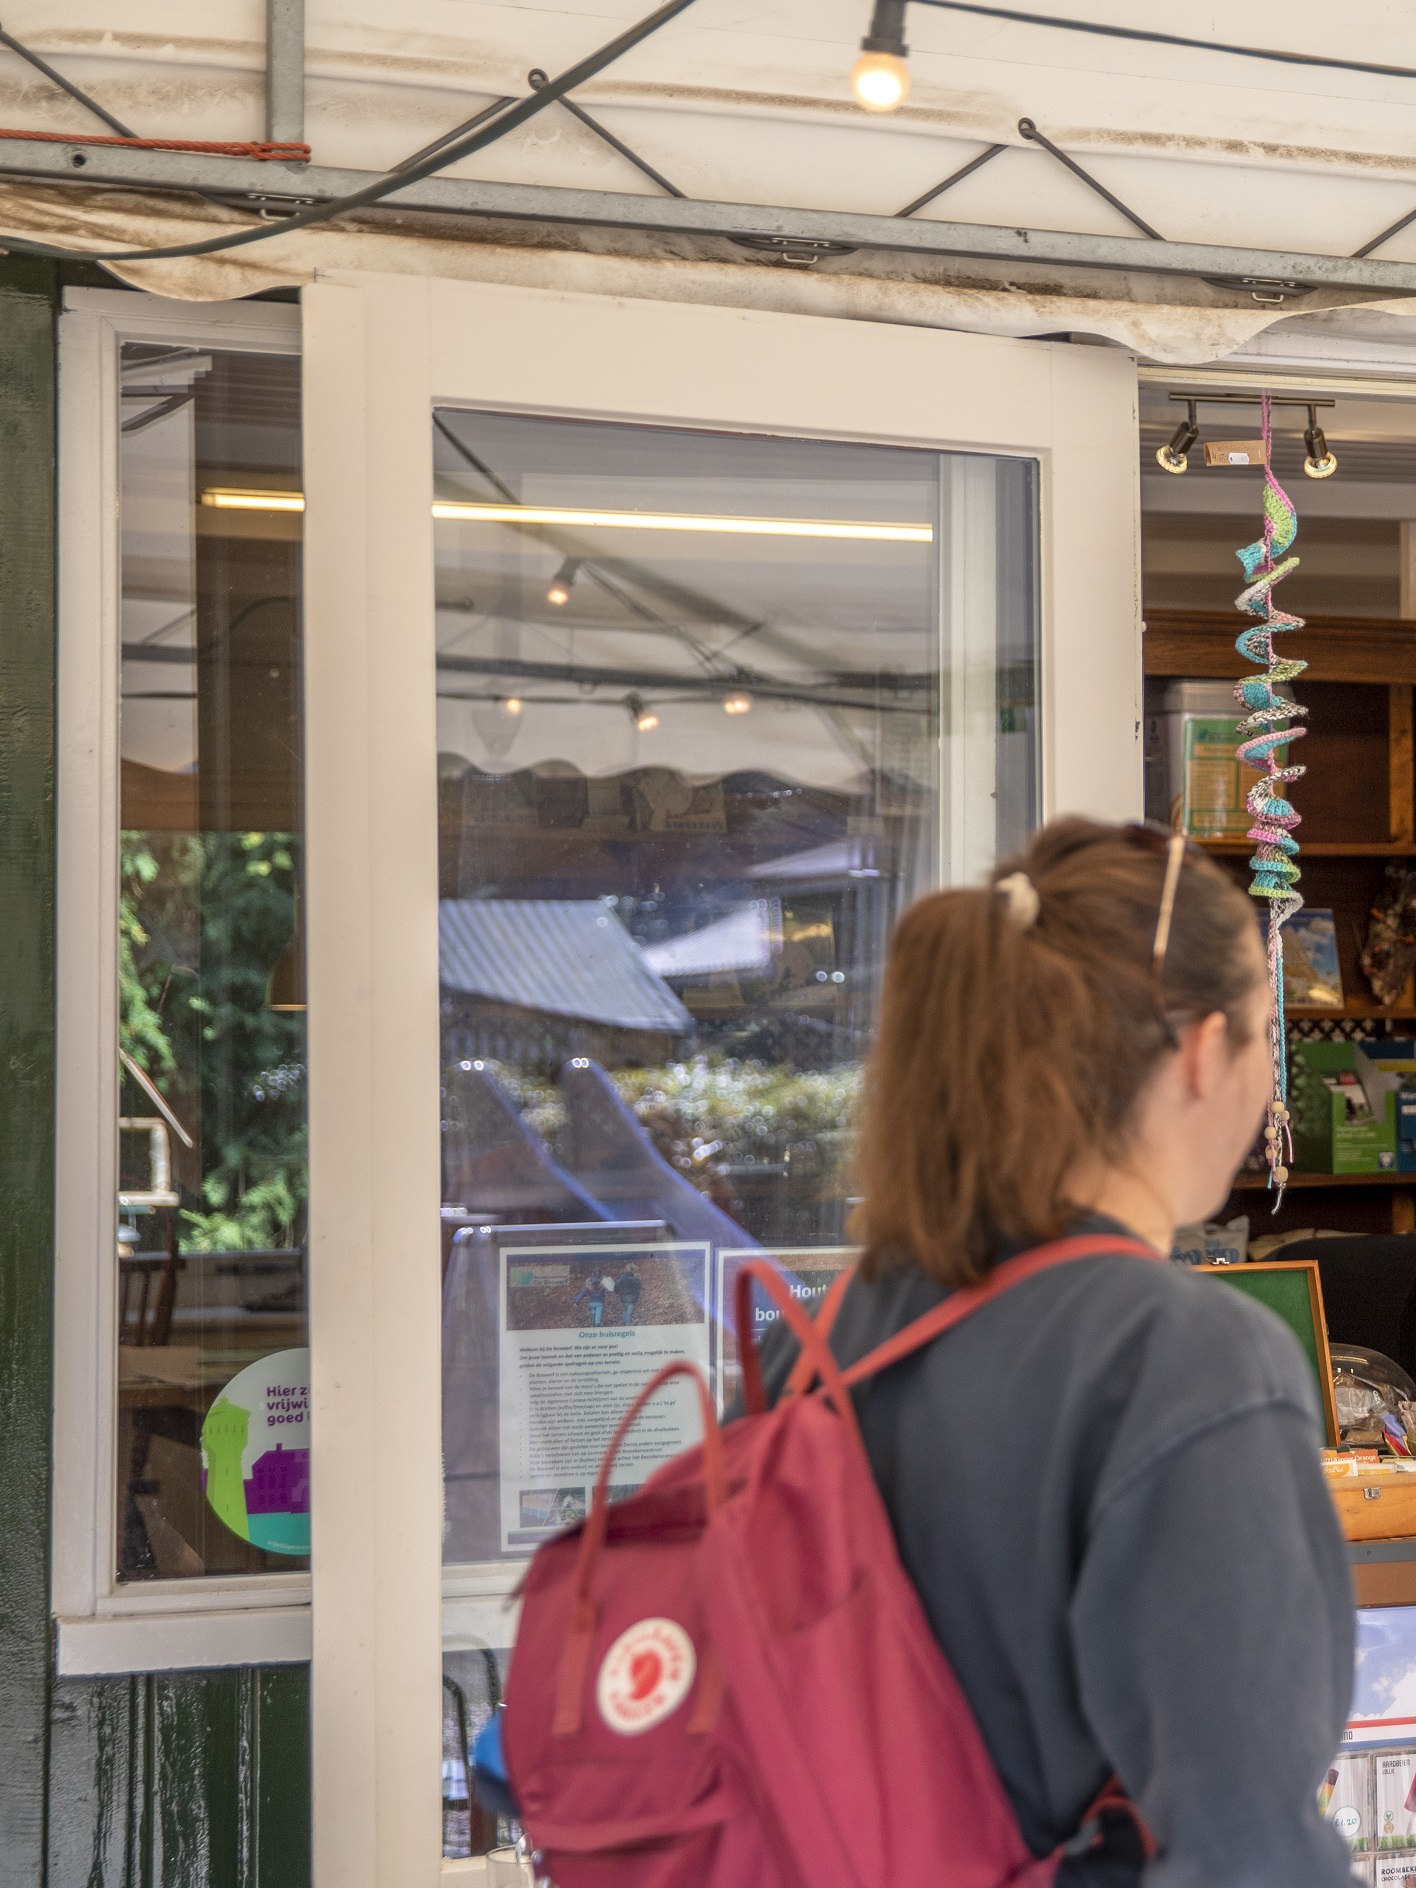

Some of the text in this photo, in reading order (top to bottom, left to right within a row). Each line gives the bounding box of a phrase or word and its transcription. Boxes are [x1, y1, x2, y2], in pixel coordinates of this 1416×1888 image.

[579, 1330, 636, 1339] Onze huisregels
[266, 1386, 297, 1398] Hier
[266, 1412, 304, 1426] goed
[1354, 1454, 1376, 1462] Orange
